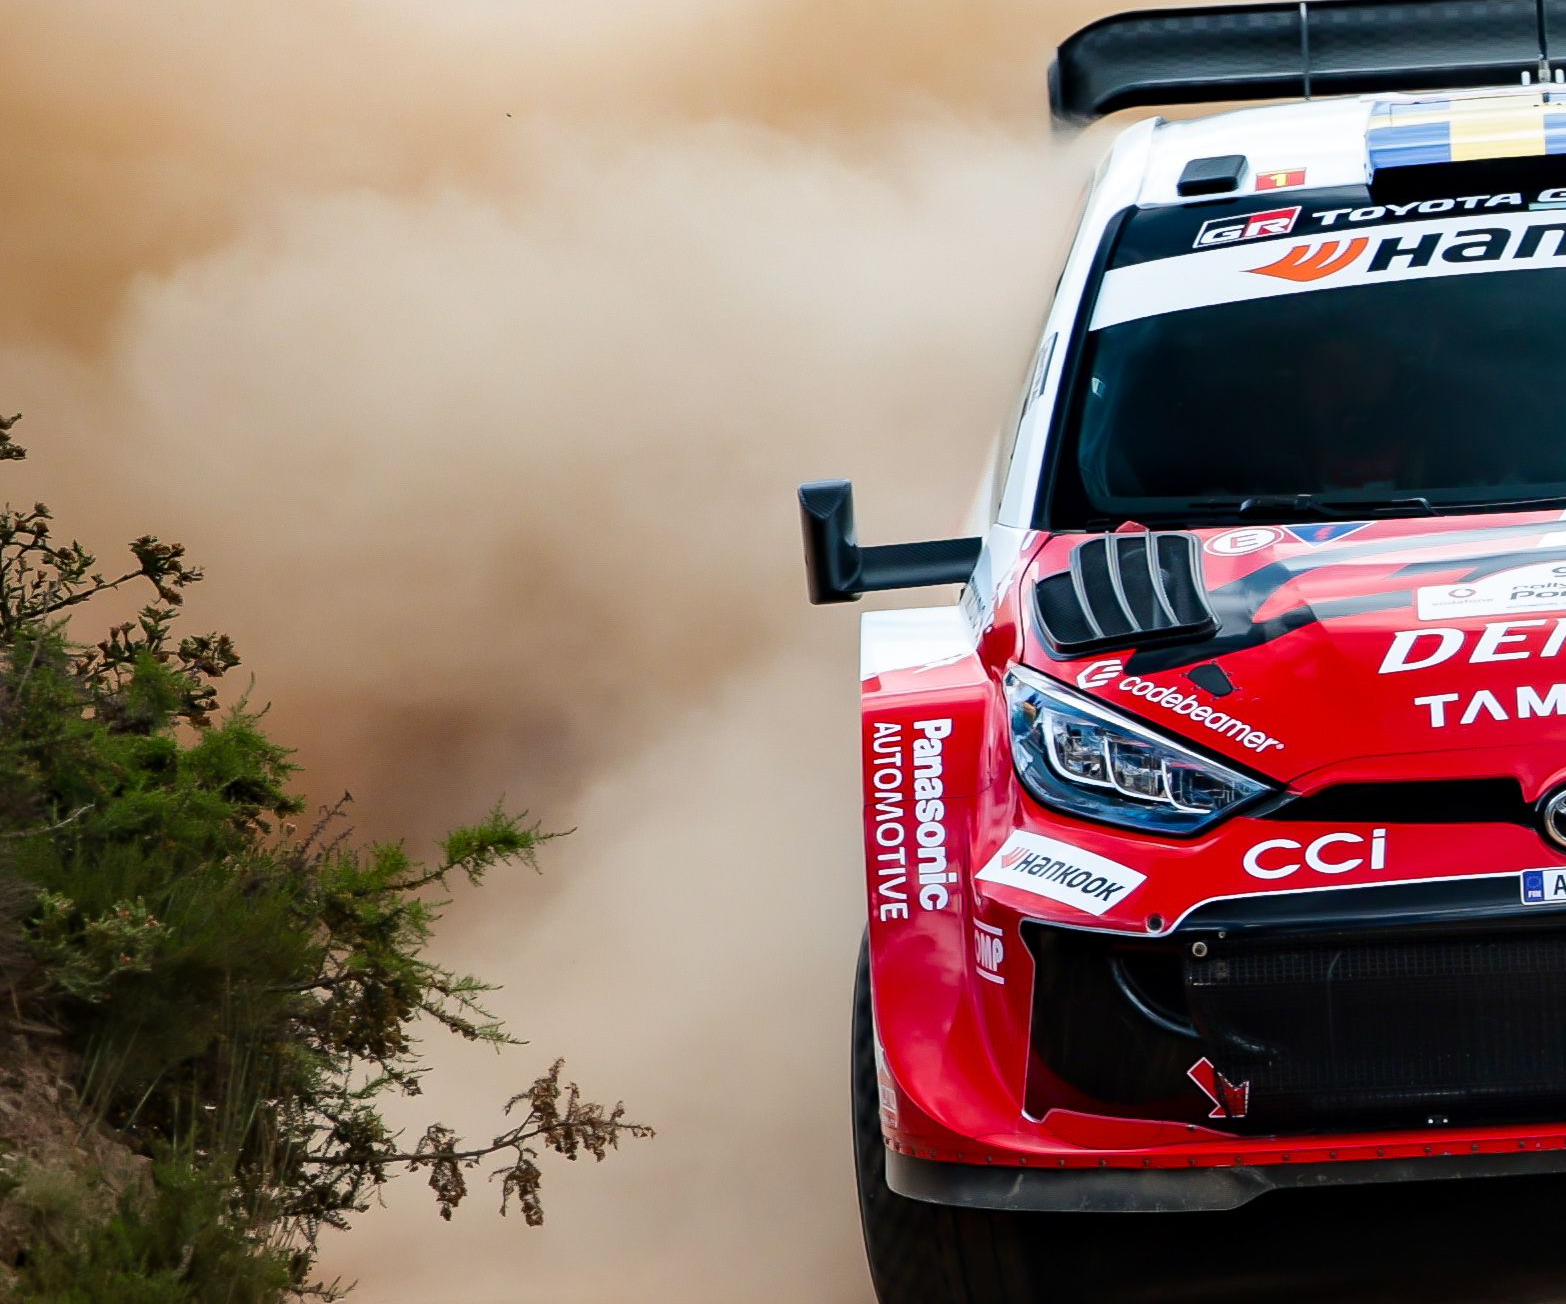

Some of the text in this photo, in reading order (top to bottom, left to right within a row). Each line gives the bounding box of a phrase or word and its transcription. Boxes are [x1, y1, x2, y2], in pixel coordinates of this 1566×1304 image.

[1201, 215, 1292, 245] GR
[1312, 193, 1522, 226] TOYOTA
[1118, 675, 1281, 753] codebeamer
[872, 721, 909, 923] AUTOMOTIVE
[912, 717, 957, 912] Panasonic
[974, 929, 1004, 972] OMP
